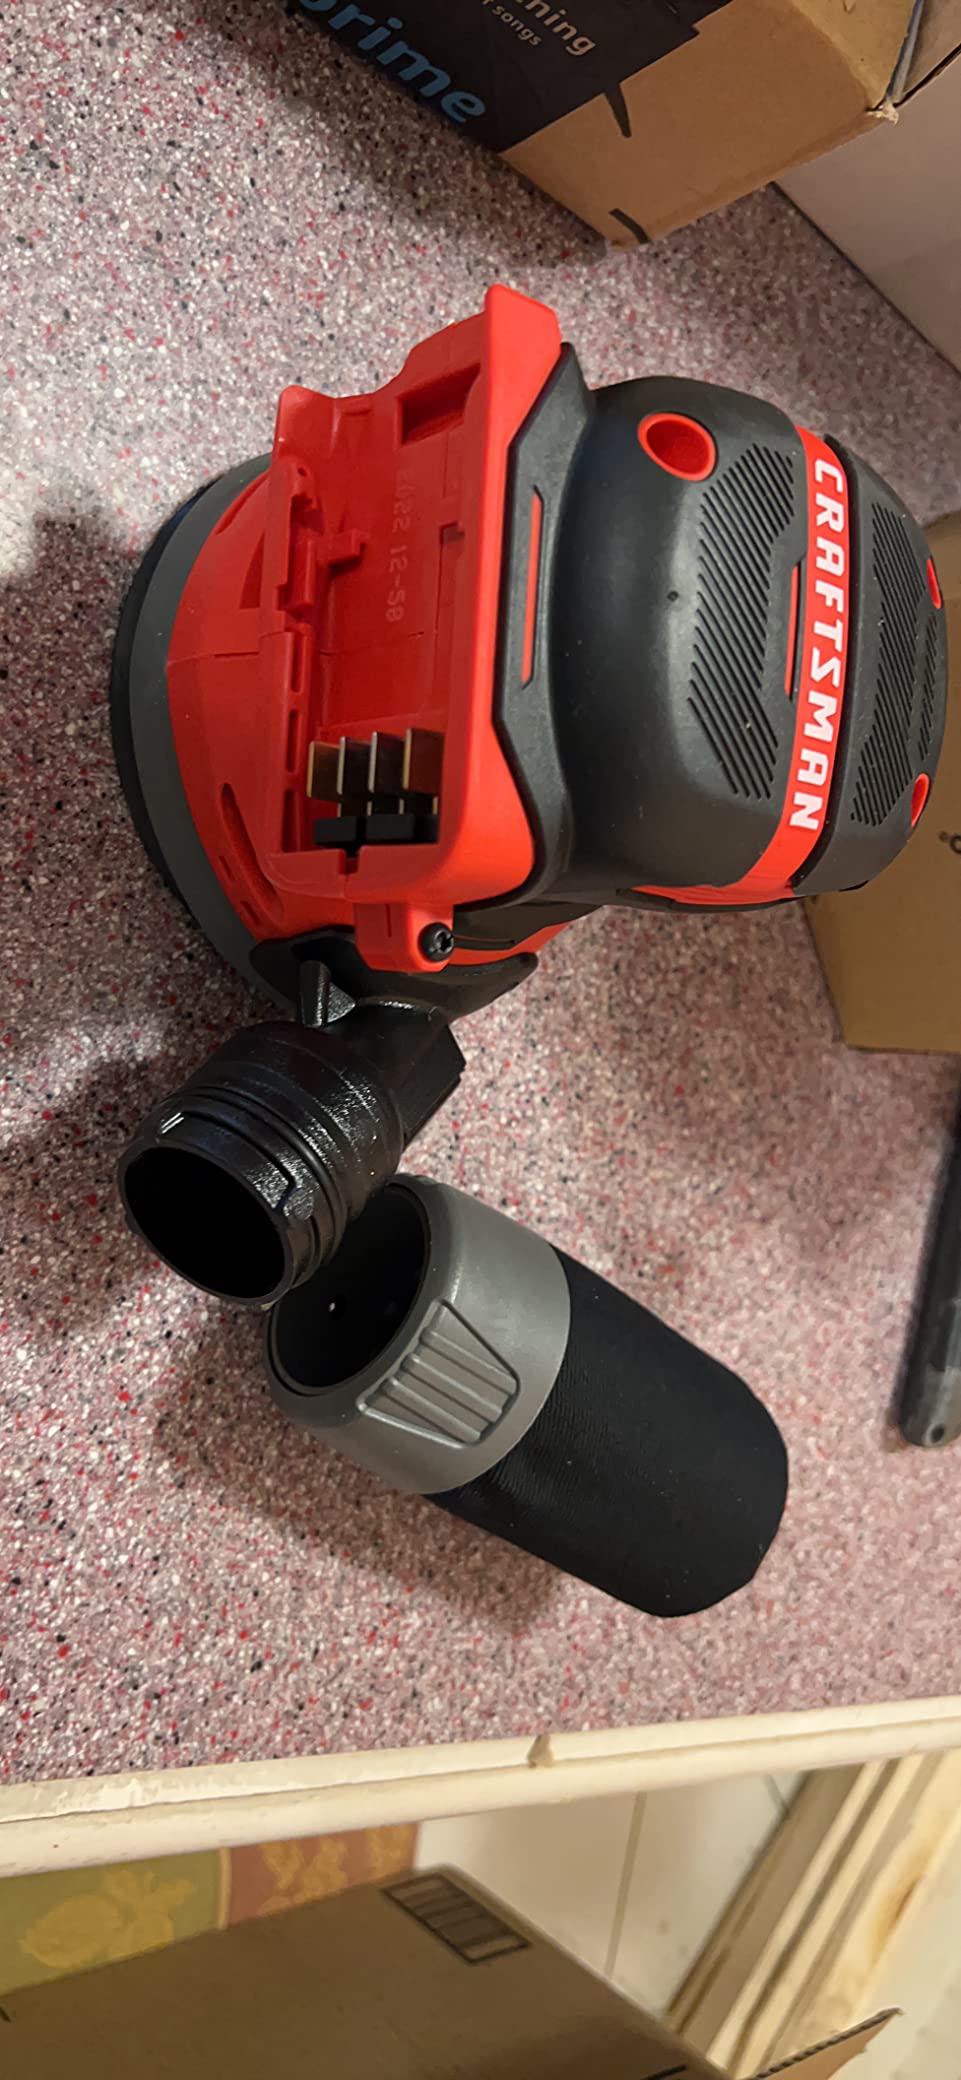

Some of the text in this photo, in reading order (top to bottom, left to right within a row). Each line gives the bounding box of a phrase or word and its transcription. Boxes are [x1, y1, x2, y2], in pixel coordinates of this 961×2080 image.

[492, 5, 542, 45] songs
[516, 0, 596, 55] ning
[790, 458, 845, 831] CRAFTSMAN
